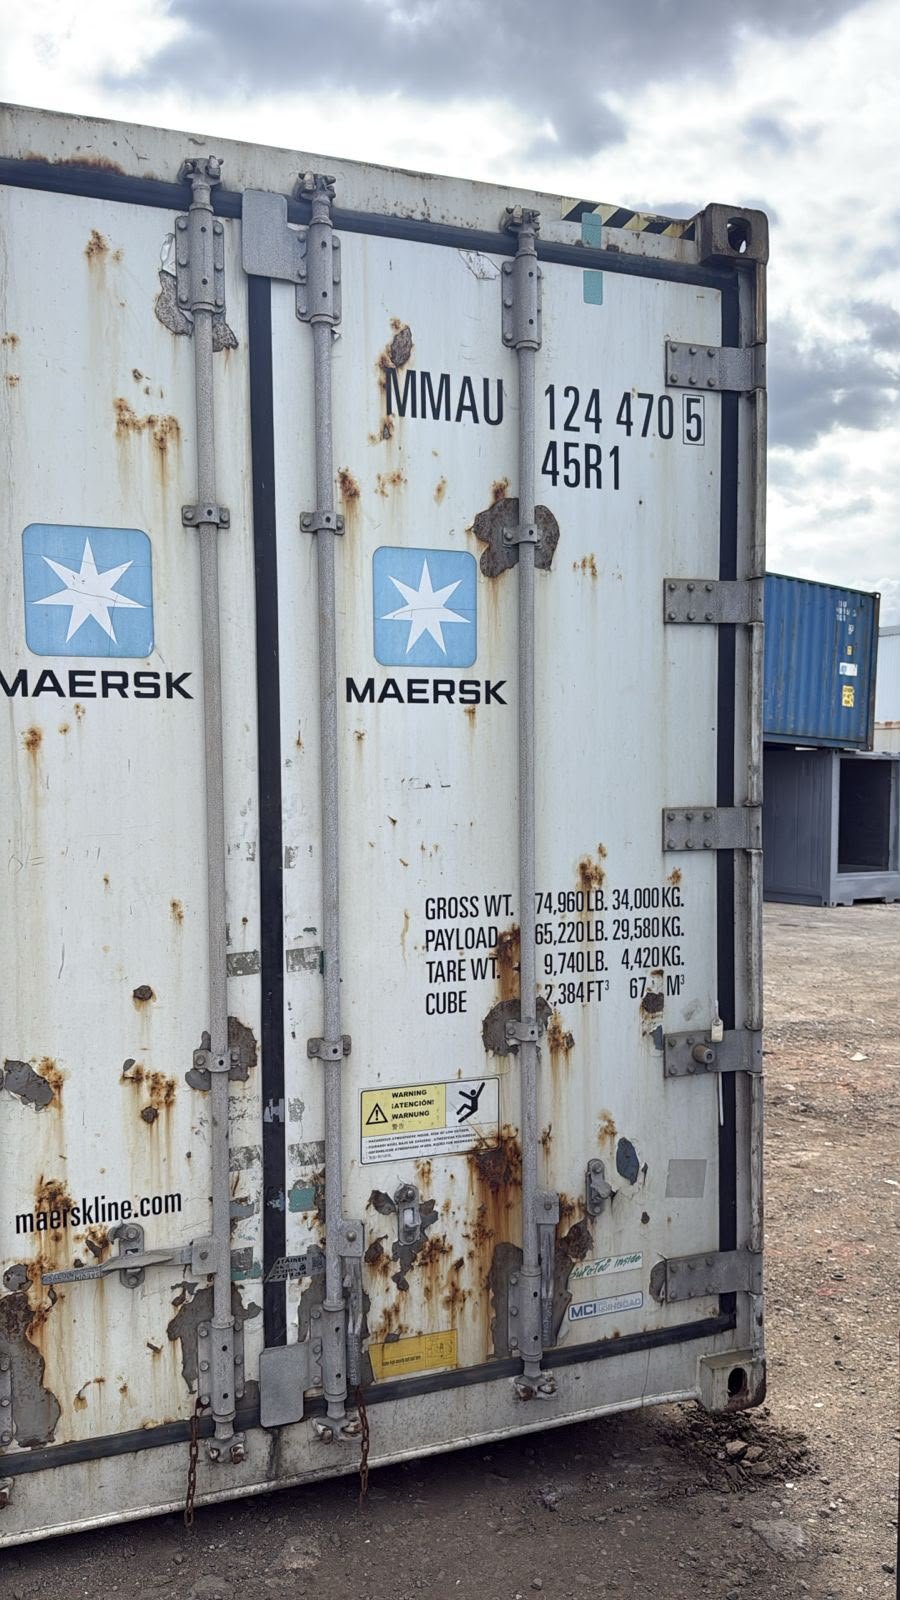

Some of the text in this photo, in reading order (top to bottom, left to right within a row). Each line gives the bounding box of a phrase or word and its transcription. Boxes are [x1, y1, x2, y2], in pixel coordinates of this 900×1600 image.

[386, 367, 703, 442] MMAU 124 470 5
[541, 440, 620, 490] 45R1
[0, 668, 194, 700] MAERSK
[346, 677, 508, 706] MAERSK
[425, 896, 479, 920] GROSS
[484, 894, 514, 917] WT.
[425, 926, 498, 952] PAYLOAD
[426, 959, 466, 984] TARE
[471, 957, 501, 980] WT.
[425, 991, 468, 1016] CUBE
[391, 1089, 427, 1098] WARNING
[391, 1110, 430, 1120] WARNUNG
[15, 1192, 182, 1235] maerskline.com
[571, 1303, 597, 1319] MCI
